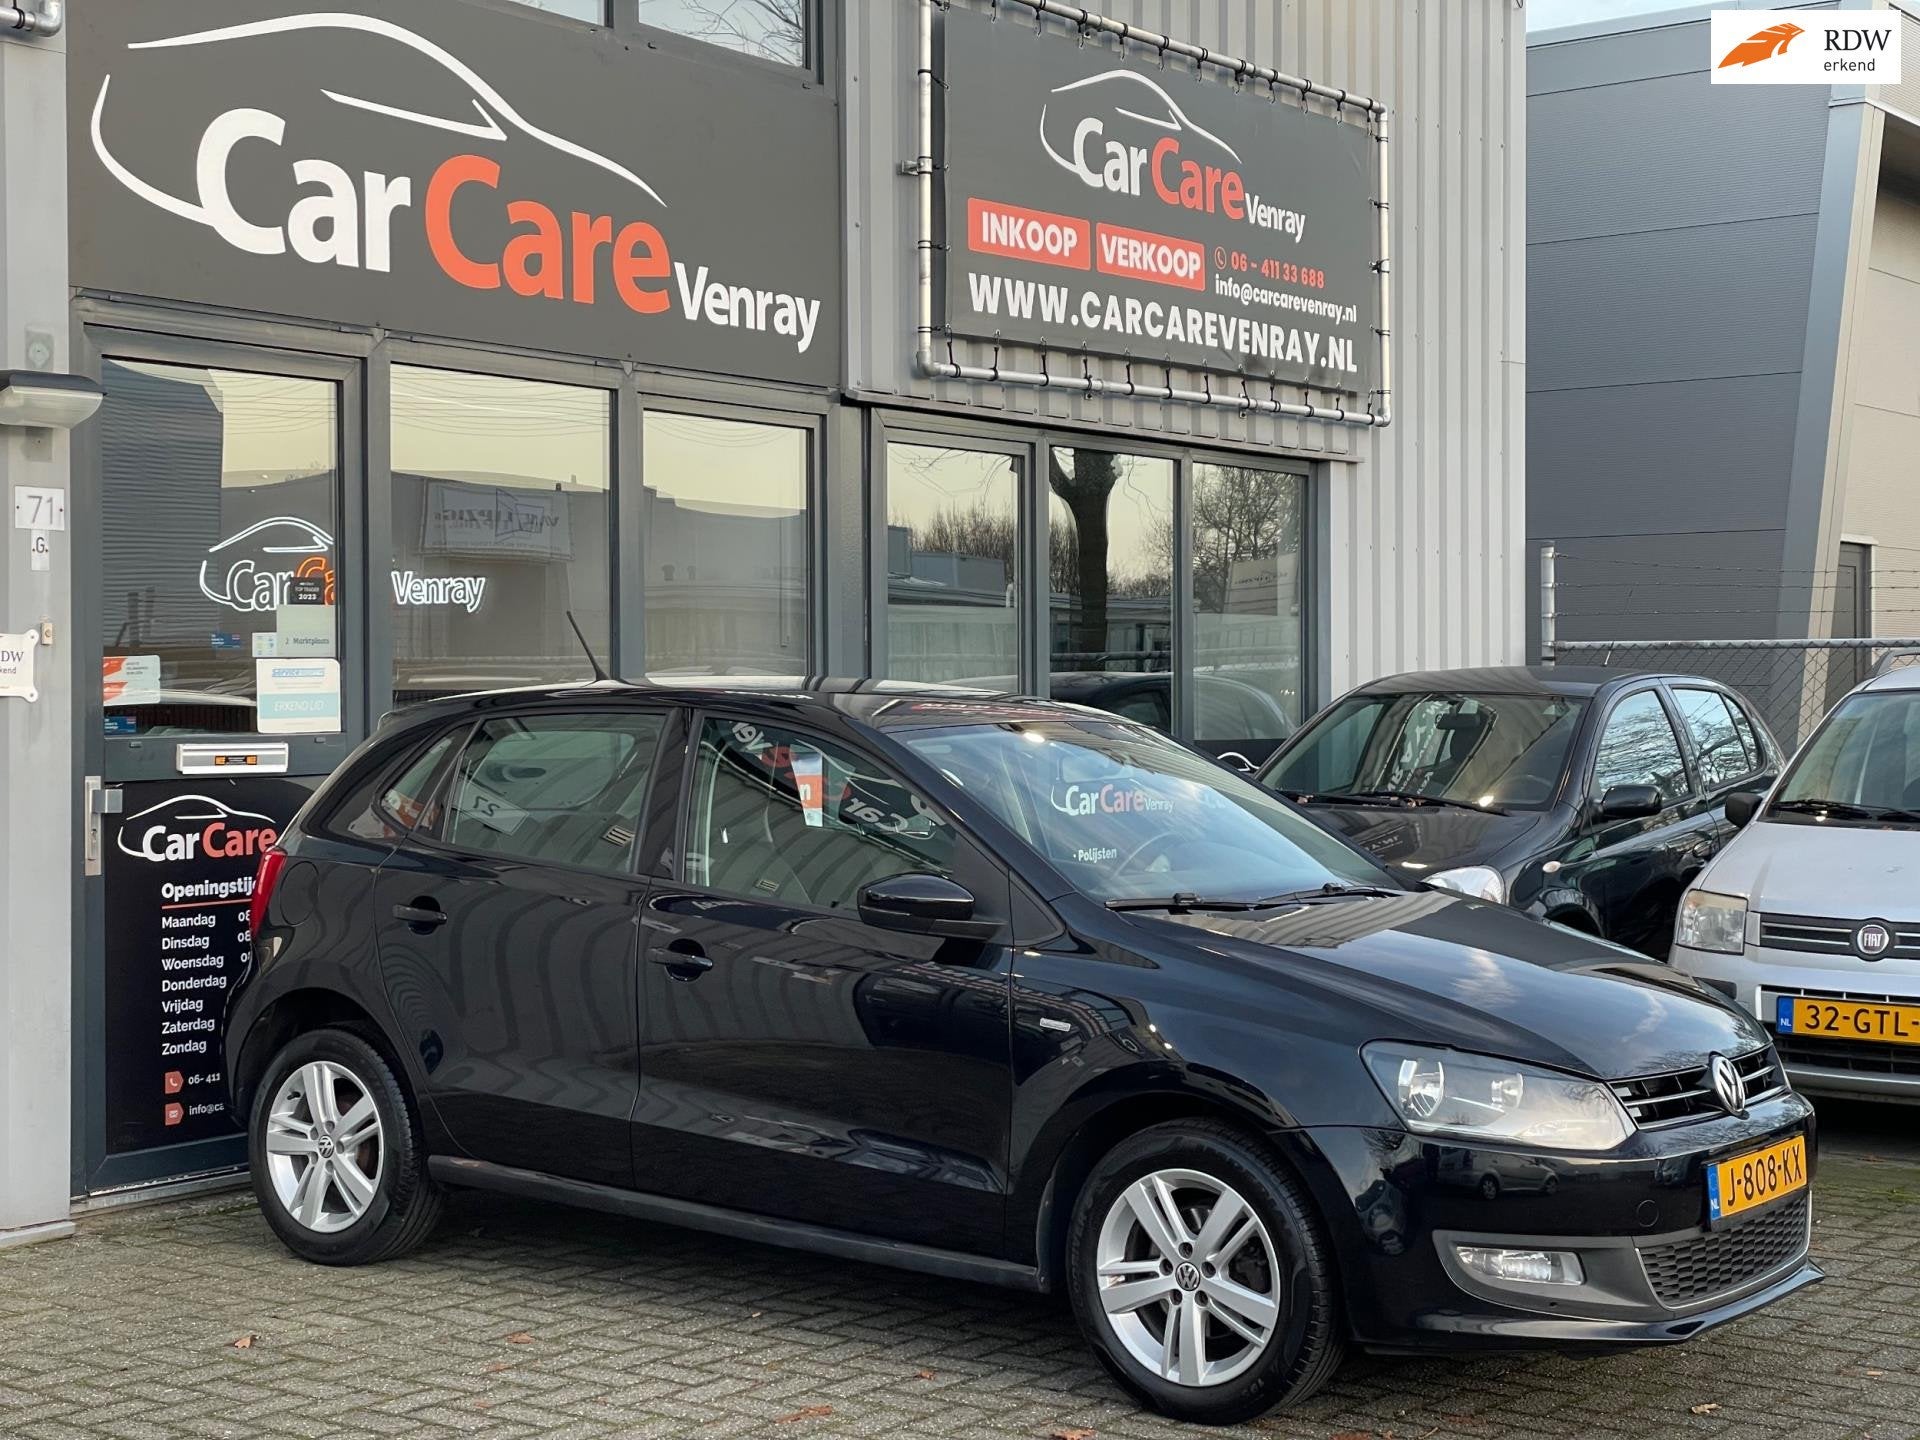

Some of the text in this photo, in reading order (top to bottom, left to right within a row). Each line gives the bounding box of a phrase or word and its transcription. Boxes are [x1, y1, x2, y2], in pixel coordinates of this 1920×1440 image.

[1244, 192, 1307, 243] Venray
[982, 210, 1078, 258] INKOOP
[1101, 232, 1201, 281] VERKOOP
[1231, 251, 1248, 272] 06
[1261, 258, 1281, 280] 411
[1282, 262, 1298, 284] 33
[1301, 266, 1326, 289] 688
[673, 262, 821, 354] Venray
[1215, 273, 1358, 325] info@carcarevenray.nl
[968, 272, 1358, 374] WWW.CARCAREVENRAY.NL
[26, 494, 54, 525] 71
[390, 570, 486, 613] Venray
[1078, 847, 1118, 863] Polijsten
[162, 912, 216, 929] Maandag
[162, 934, 210, 950] Dinsdag
[1863, 932, 1883, 947] FIAT
[162, 951, 251, 971] Woensdag 0
[162, 974, 227, 993] Donderdag
[162, 997, 204, 1014] Vrijdag
[162, 1017, 216, 1035] Zaterdag
[1780, 1017, 1792, 1027] NL
[162, 1039, 207, 1056] Zondag
[1727, 1143, 1802, 1206] J-808-KX
